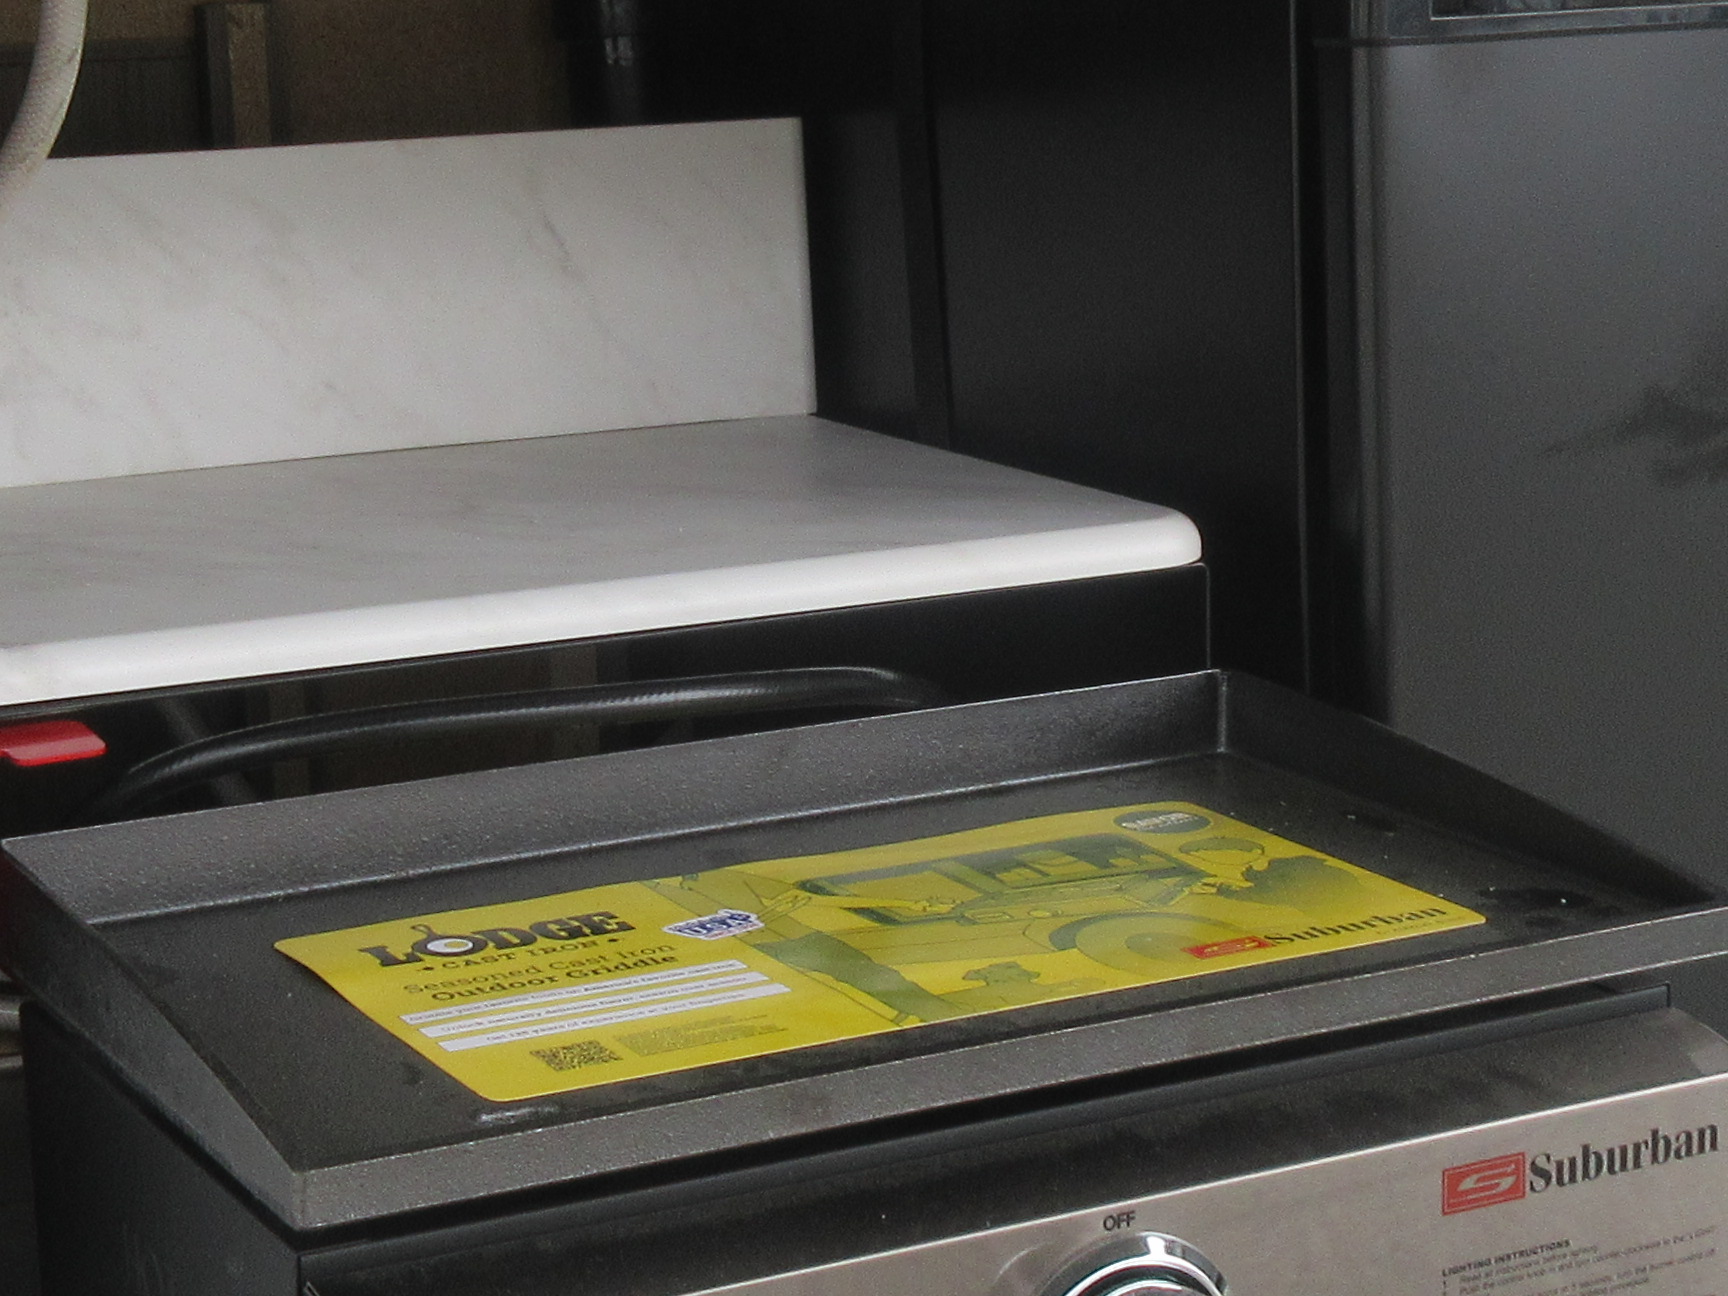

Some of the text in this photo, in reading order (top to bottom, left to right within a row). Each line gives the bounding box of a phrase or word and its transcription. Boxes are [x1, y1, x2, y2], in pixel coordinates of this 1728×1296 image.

[359, 910, 636, 967] LODGE
[1264, 907, 1447, 946] Suburban
[404, 944, 676, 994] Seasoned Cast Iron
[442, 939, 601, 970] CAST IRON
[432, 956, 678, 1001] Outdoor Griddle
[1529, 1122, 1720, 1194] Suburban
[1103, 1211, 1136, 1232] OFF
[1442, 1240, 1570, 1277] LIGHTING INSTRUCTIONS
